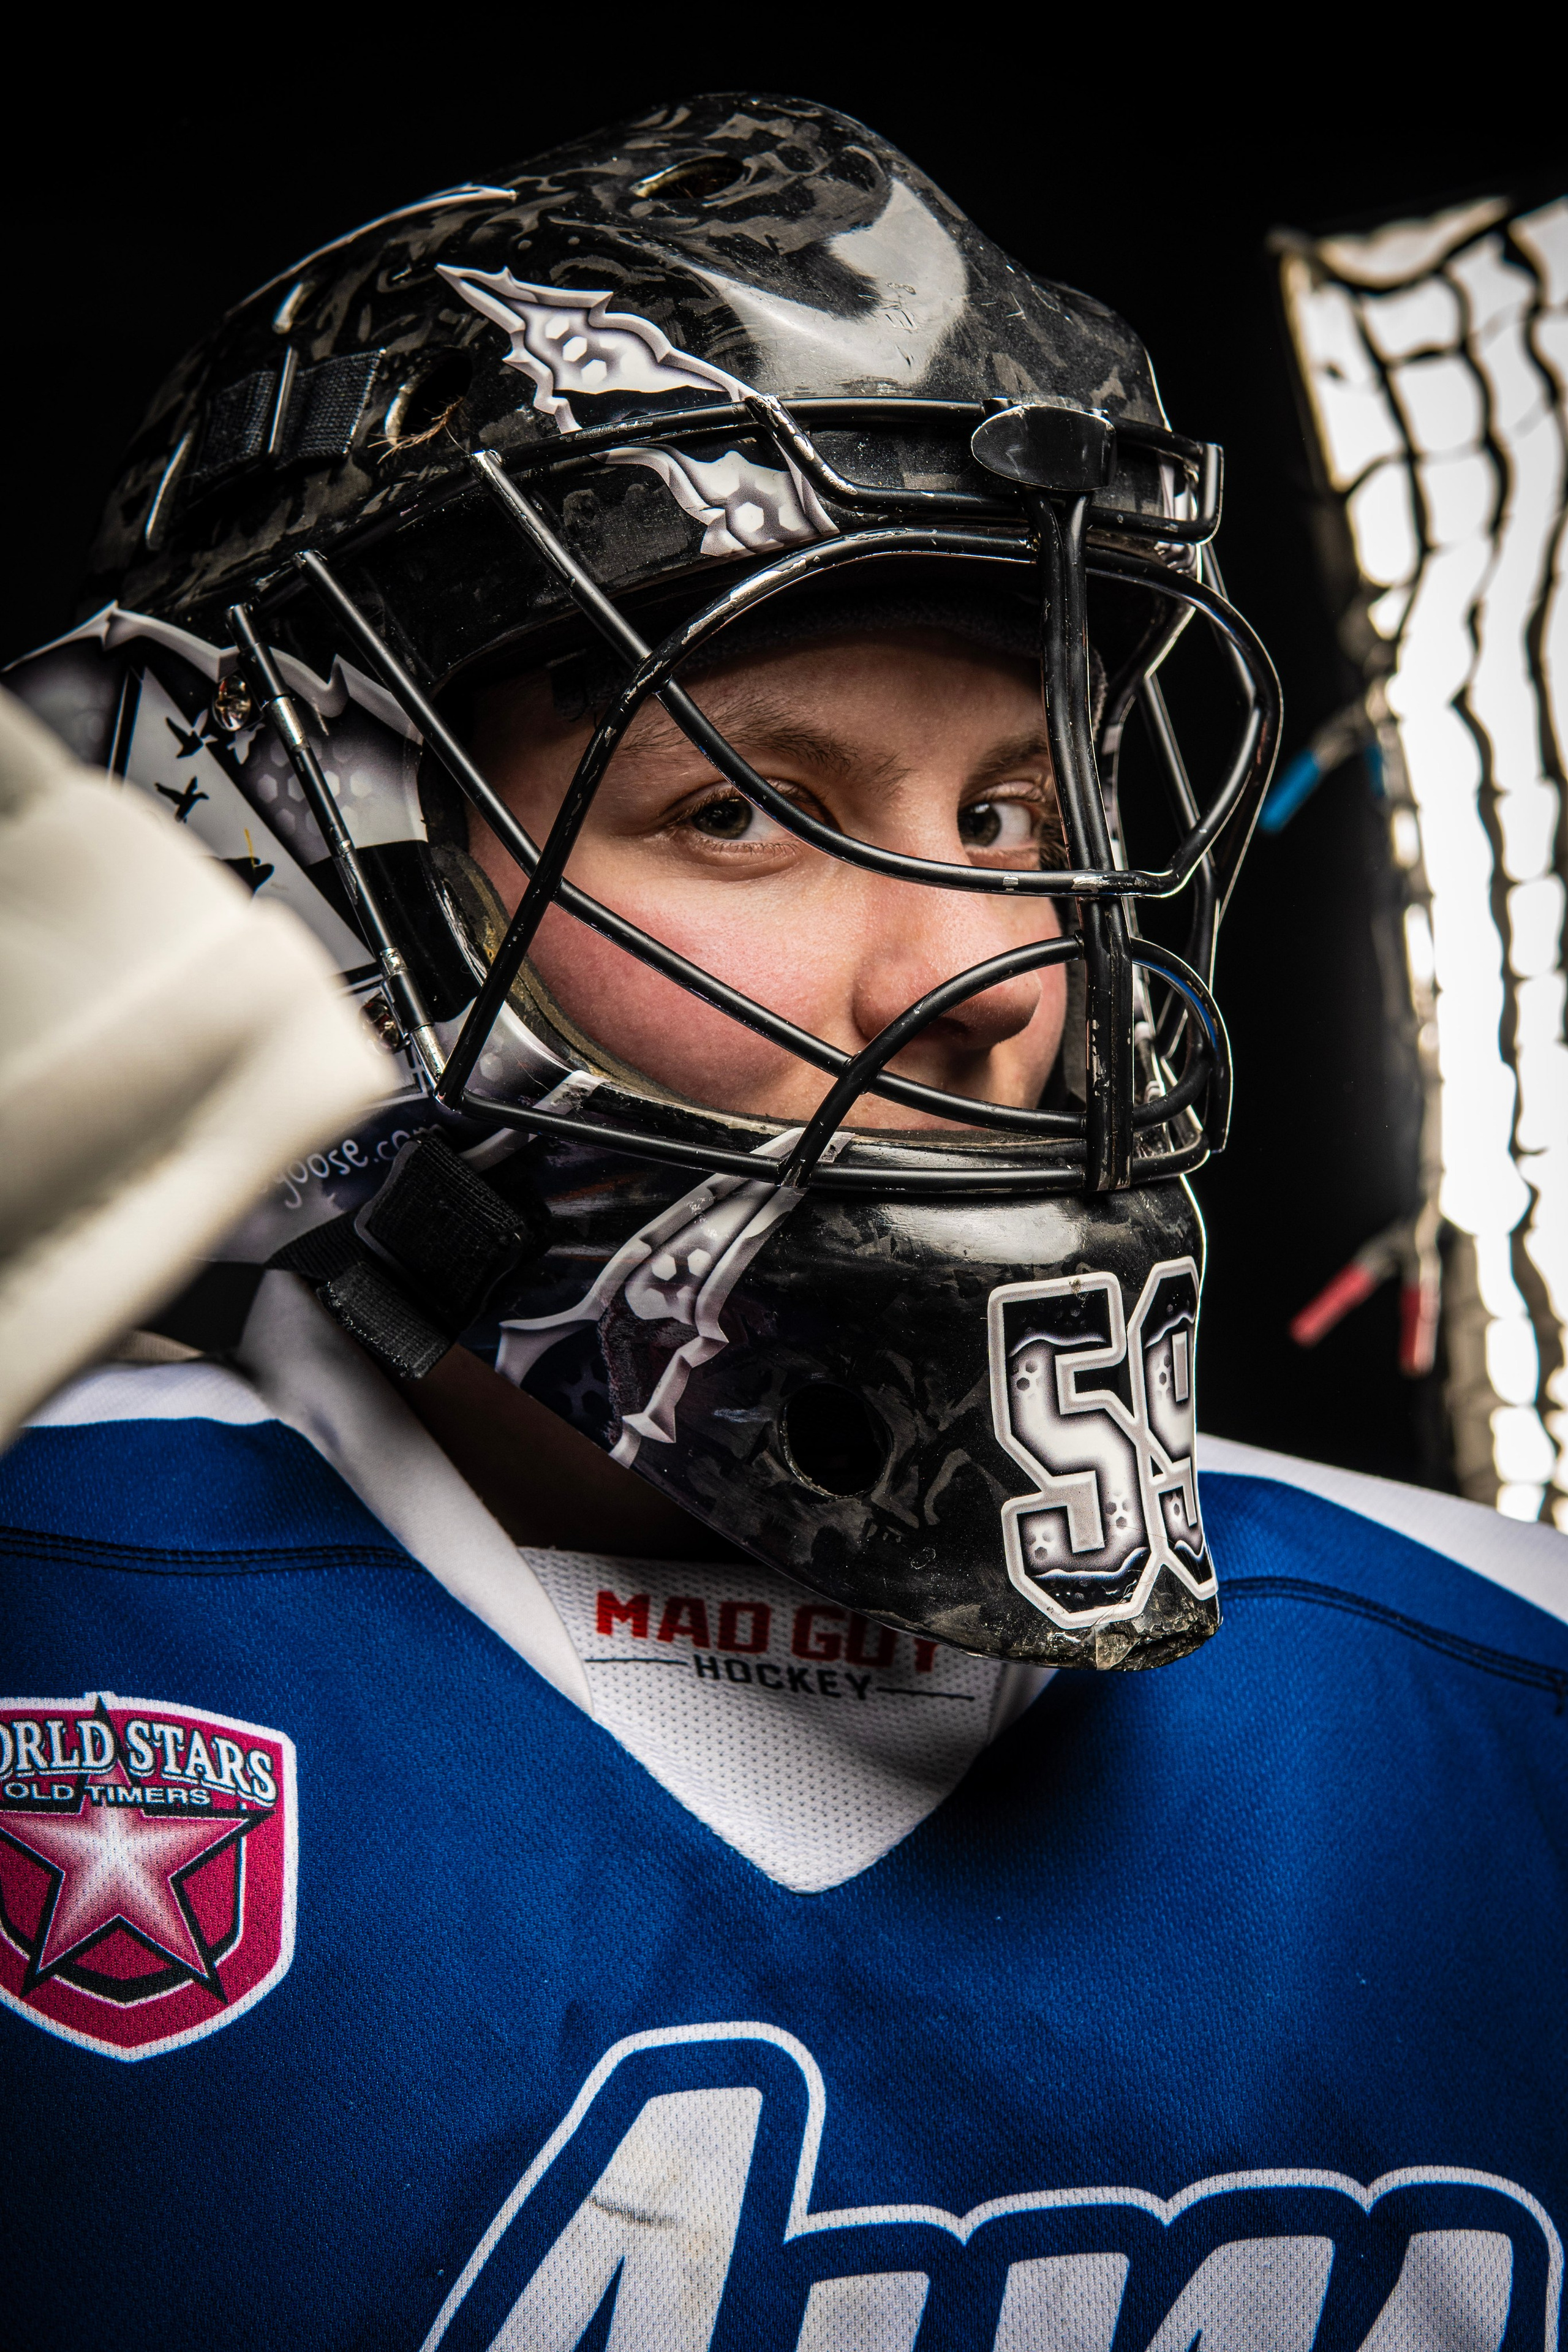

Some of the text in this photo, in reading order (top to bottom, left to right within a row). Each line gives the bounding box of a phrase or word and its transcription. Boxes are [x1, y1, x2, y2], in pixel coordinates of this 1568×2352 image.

[595, 1589, 771, 1654] MAD
[693, 1653, 872, 1701] HOCKEY
[126, 1719, 278, 1807] STARS
[4, 1782, 212, 1806] OLD TIMERS
